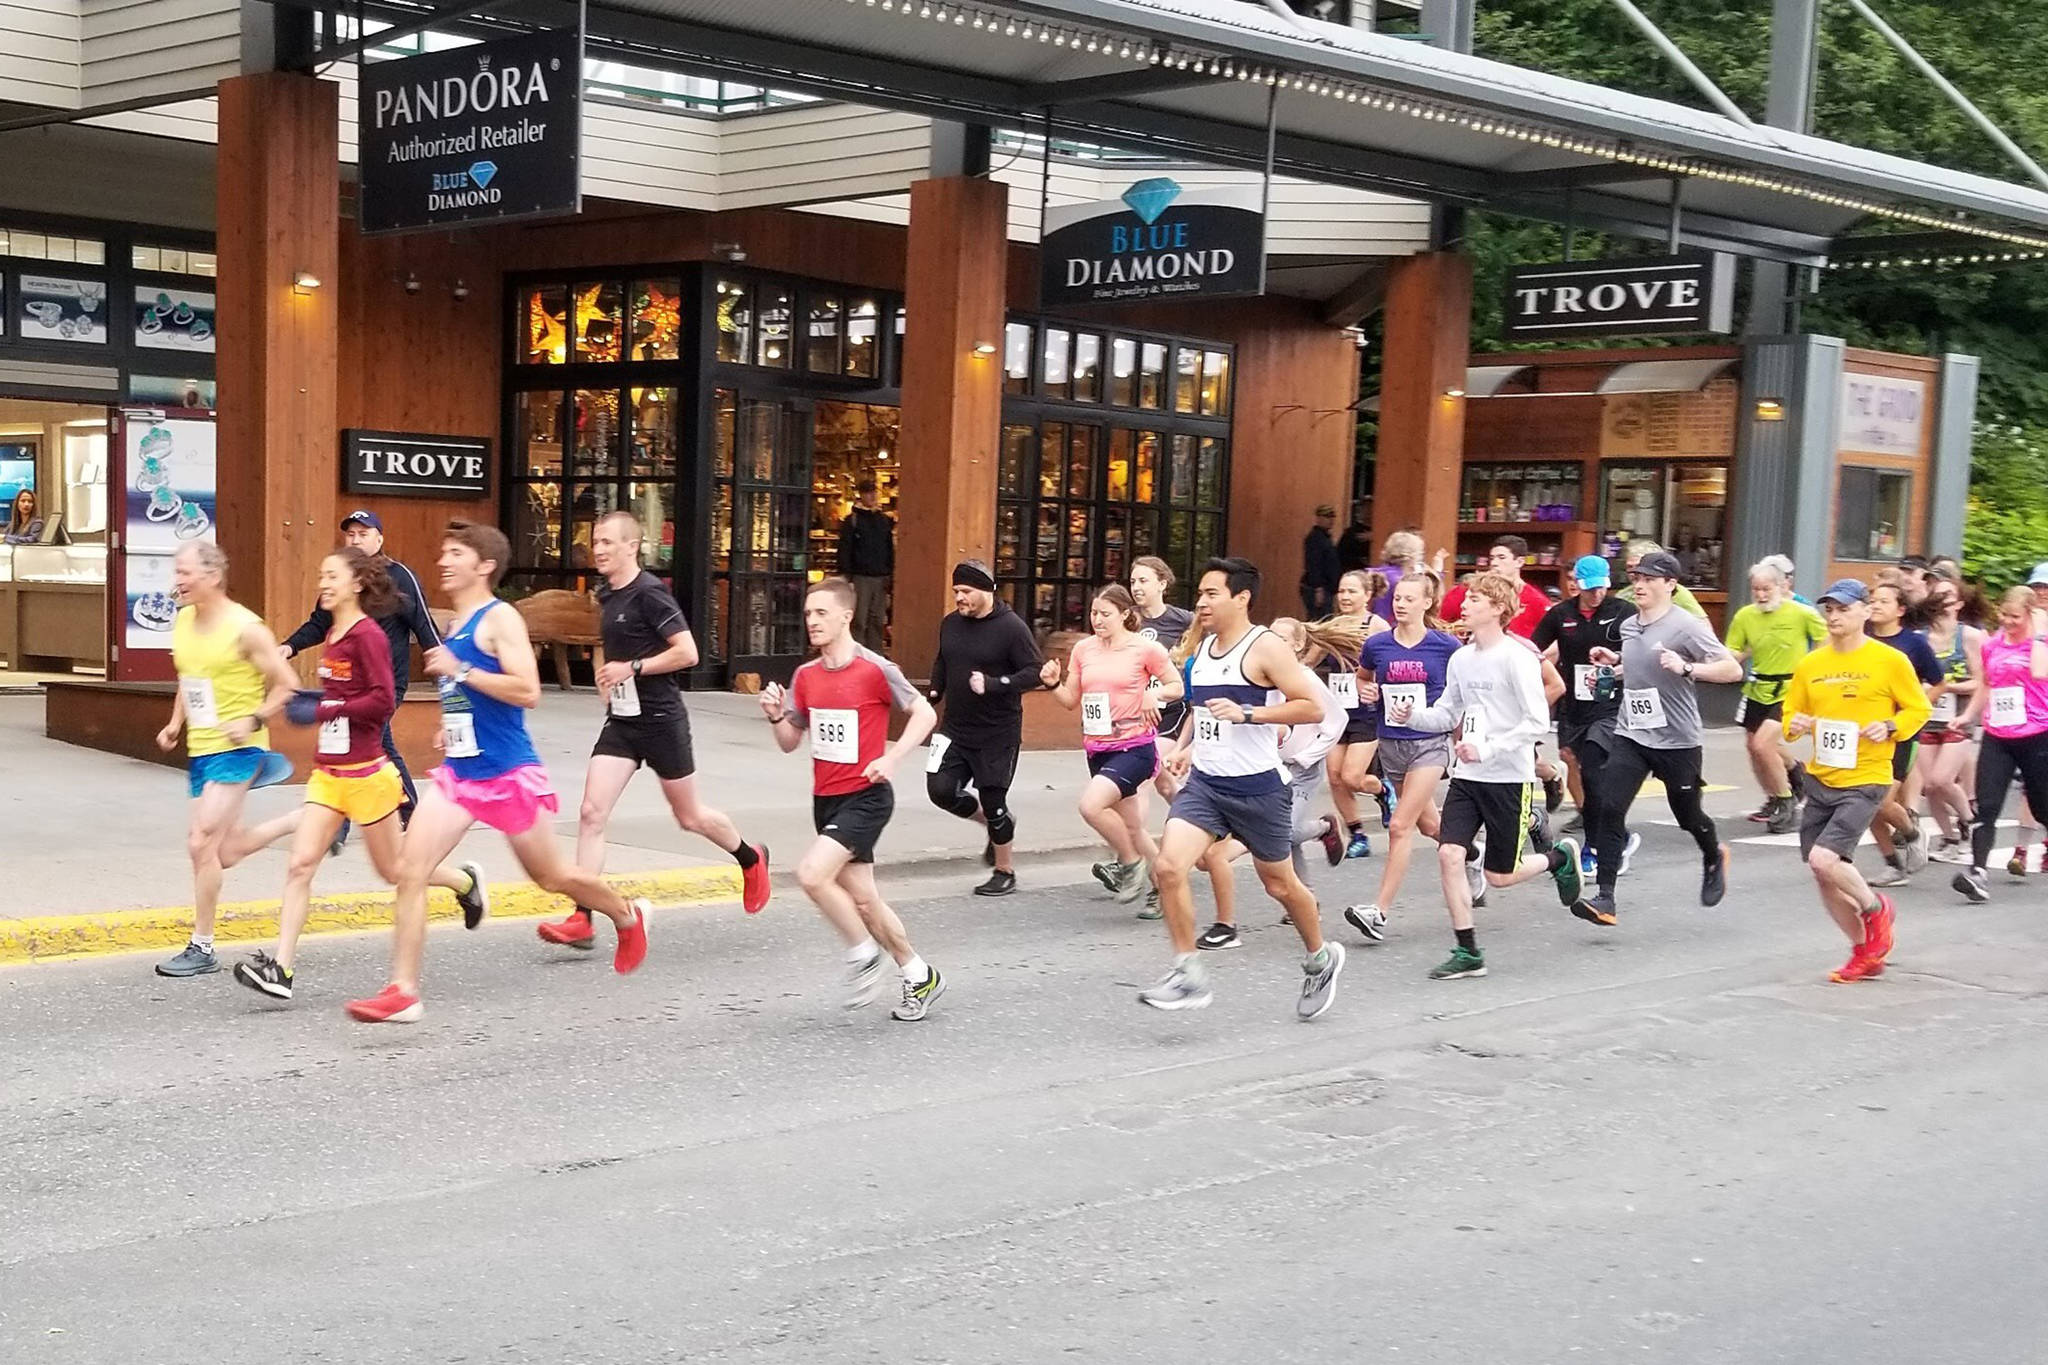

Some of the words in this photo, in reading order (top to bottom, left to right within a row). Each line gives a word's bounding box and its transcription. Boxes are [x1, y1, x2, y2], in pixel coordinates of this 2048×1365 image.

[376, 62, 549, 128] PANDORA
[387, 127, 476, 164] Authorized
[481, 118, 547, 150] Retailer
[432, 171, 468, 191] BLUE
[428, 188, 501, 211] DIAMOND
[1111, 223, 1188, 254] BLUE
[1066, 249, 1234, 287] DIAMOND
[1515, 279, 1699, 315] TROVE
[358, 449, 484, 478] TROVE
[1389, 661, 1424, 672] UNDER
[1631, 700, 1653, 715] 669
[1823, 731, 1846, 750] 685
